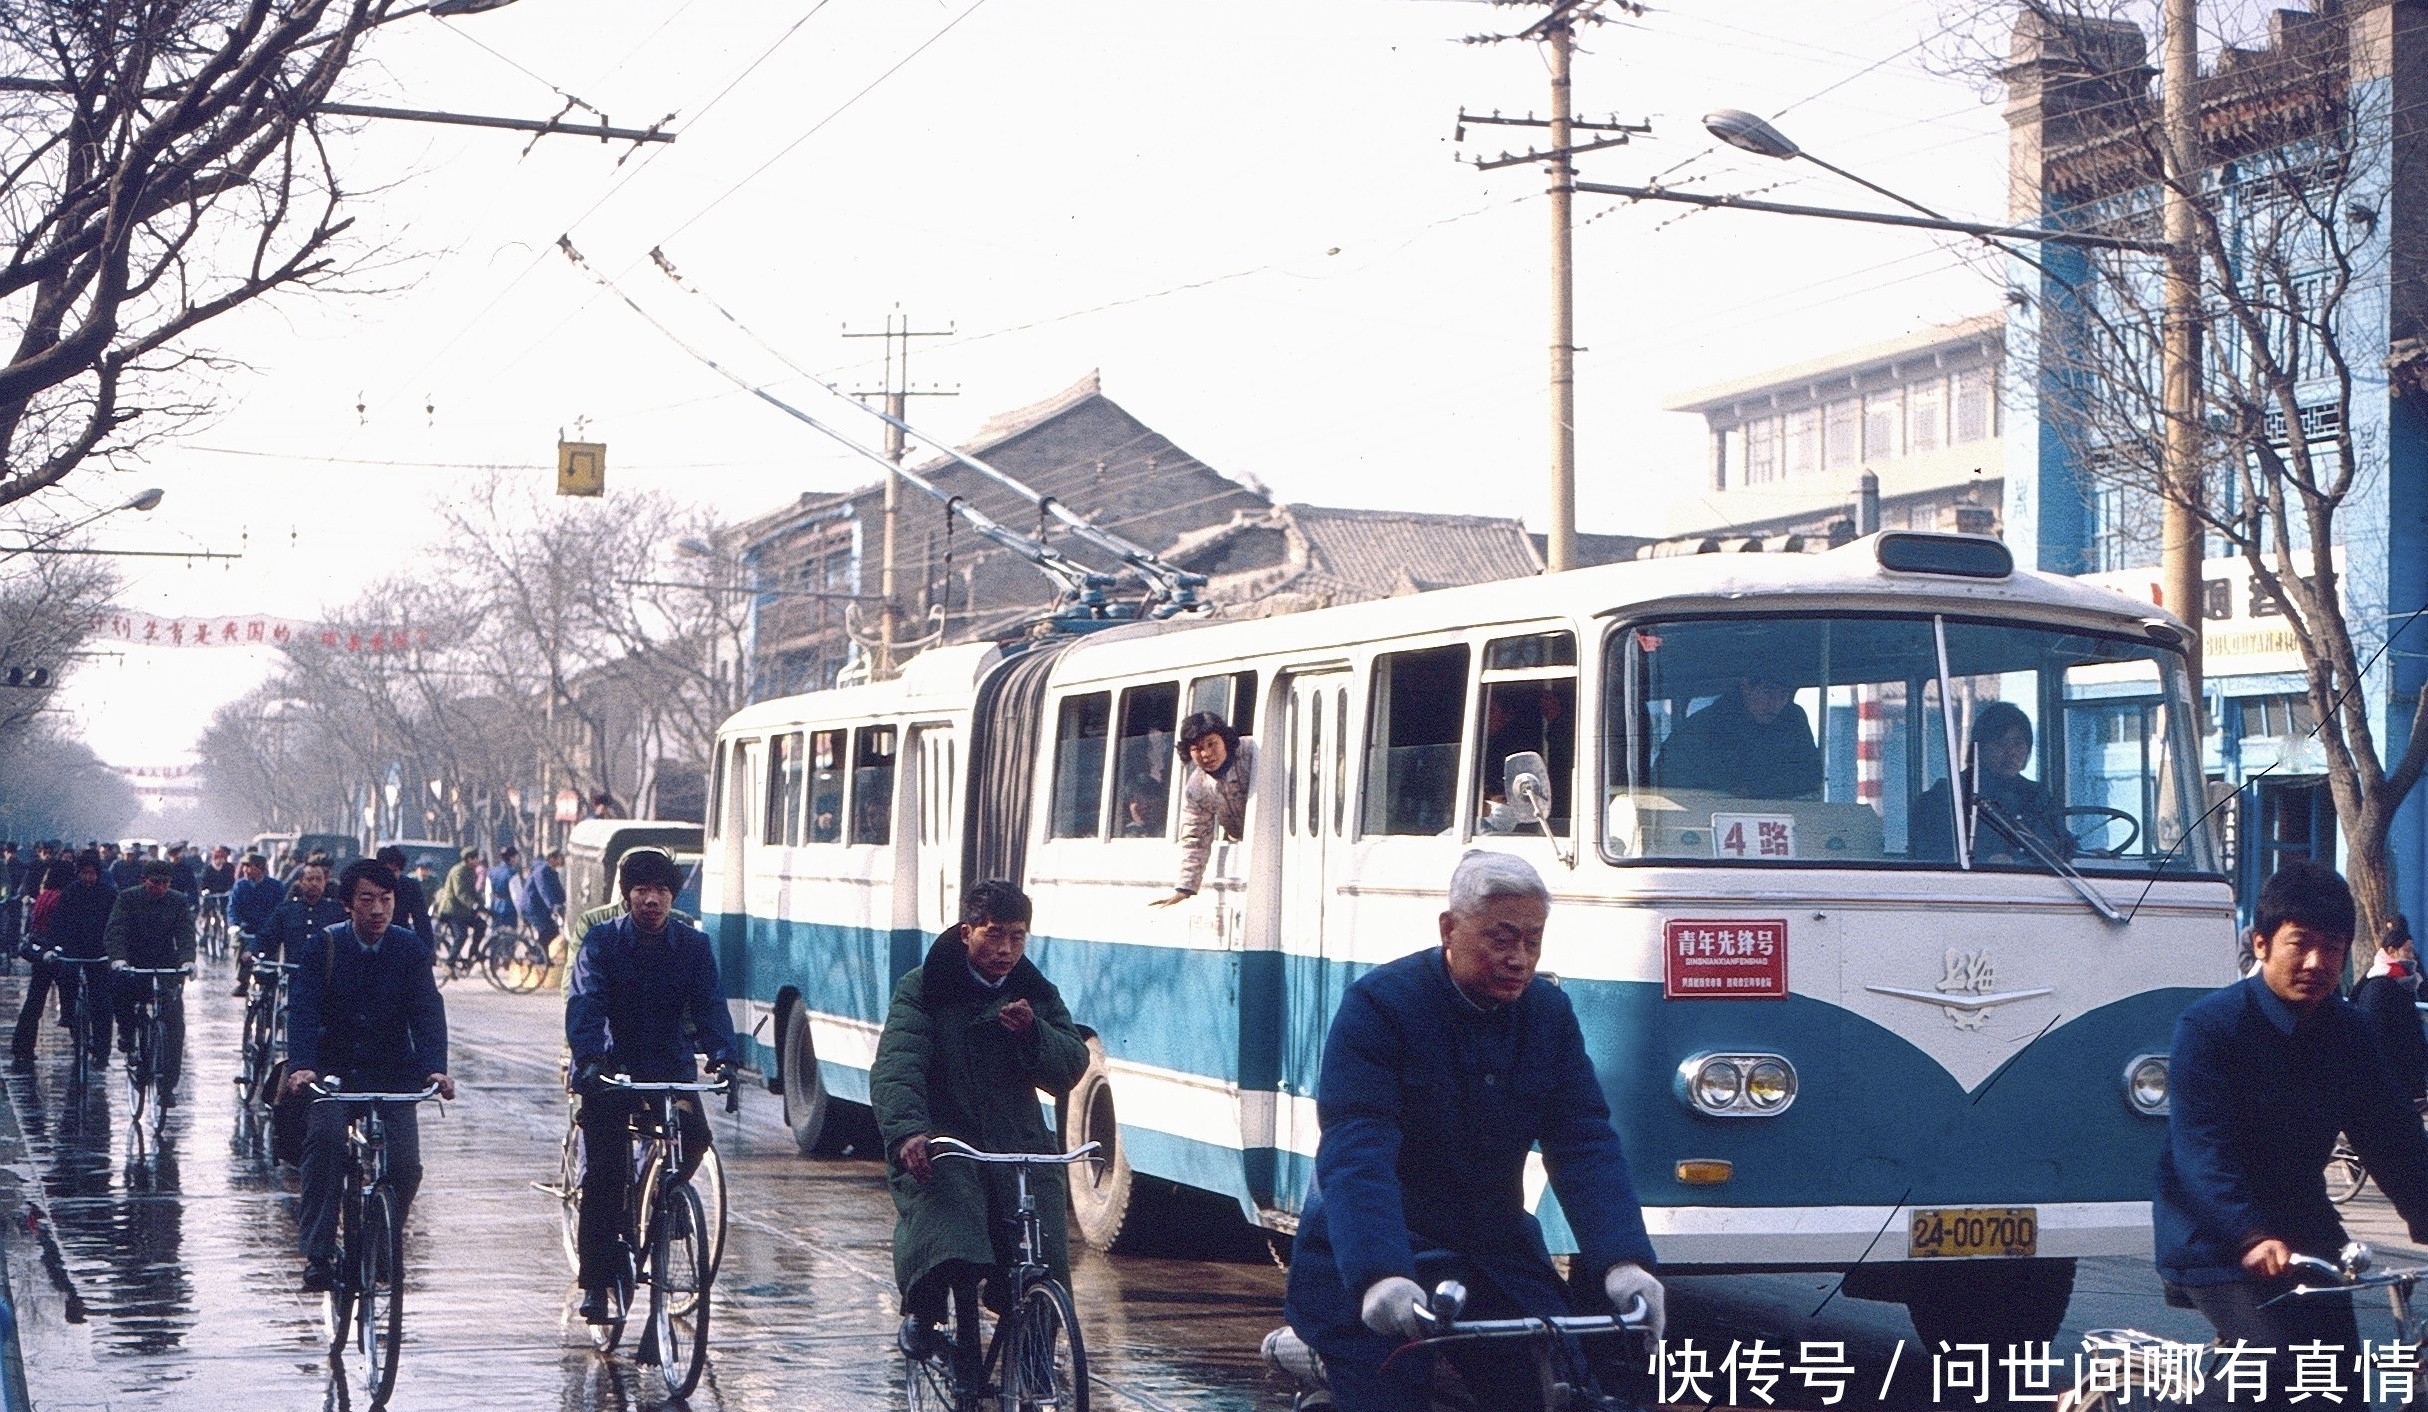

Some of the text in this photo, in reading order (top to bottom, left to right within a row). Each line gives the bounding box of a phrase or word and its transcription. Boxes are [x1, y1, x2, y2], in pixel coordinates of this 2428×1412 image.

[1677, 930, 1774, 956] 青年先锋号
[1912, 1217, 2034, 1248] 24-00700
